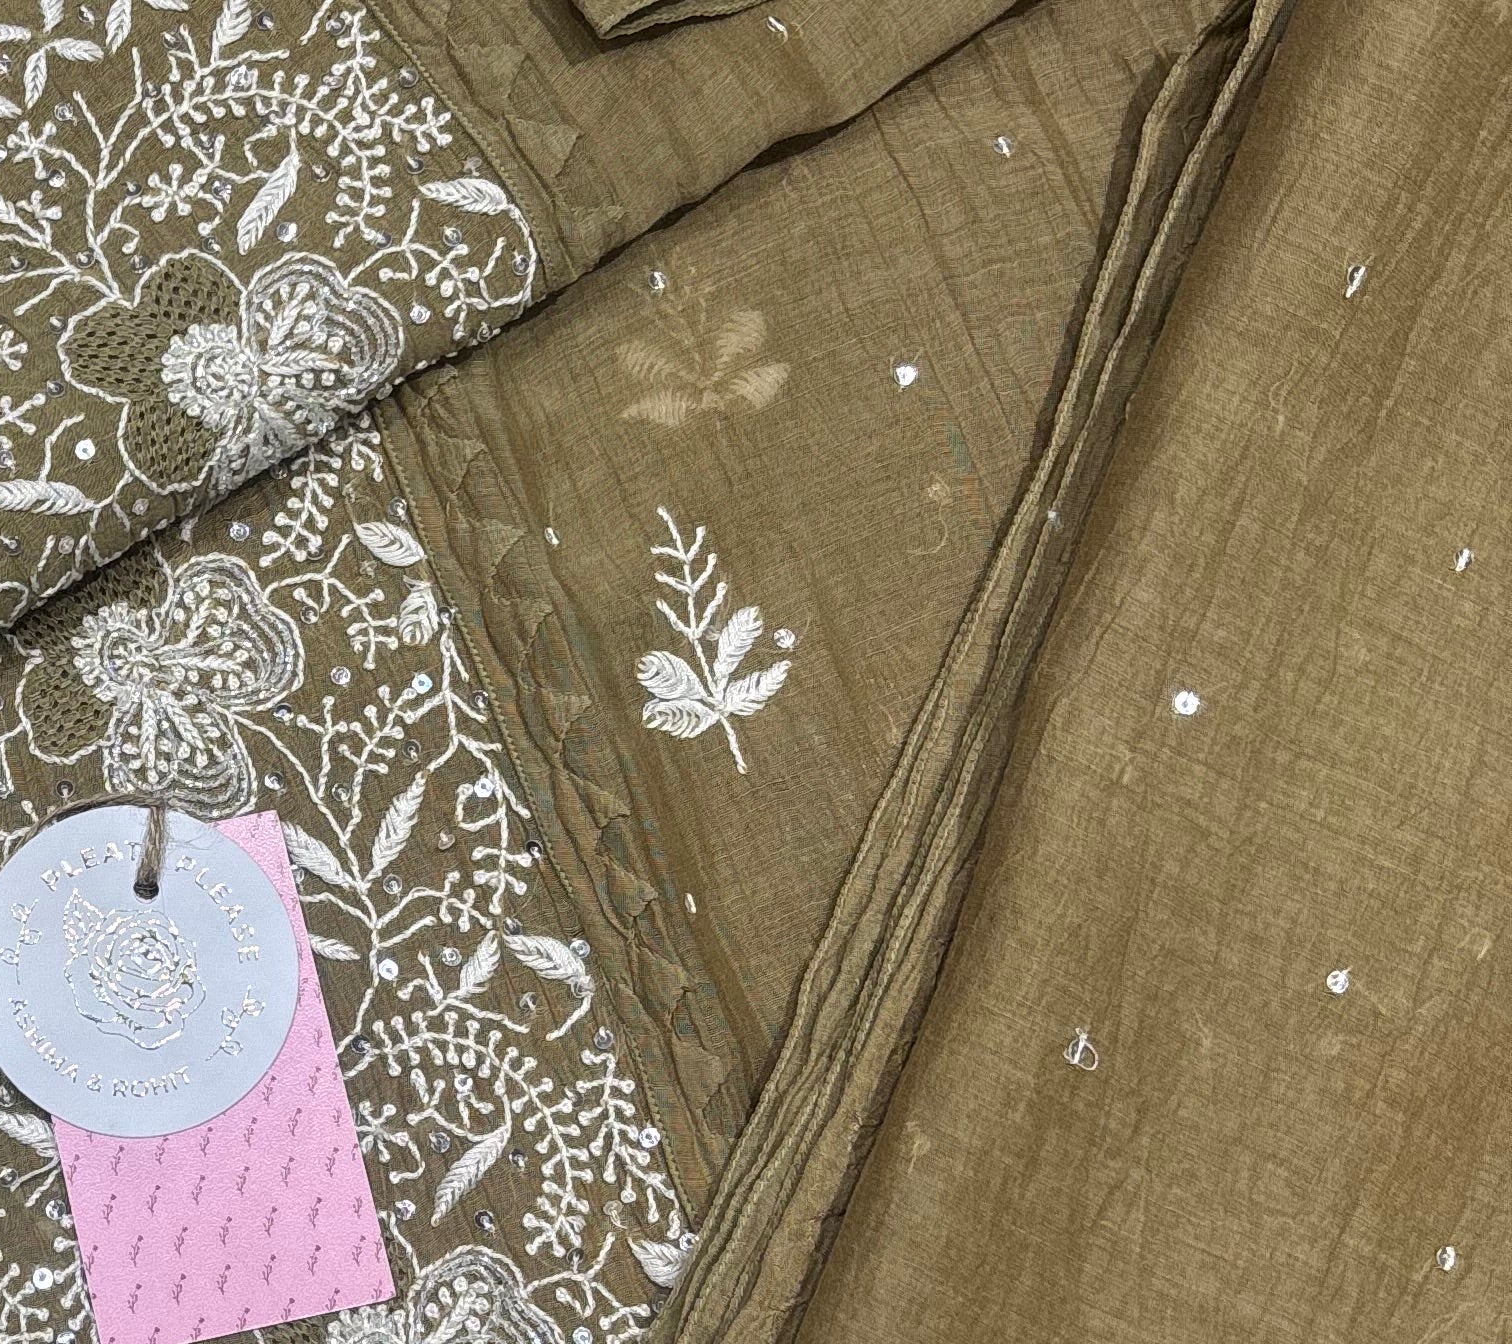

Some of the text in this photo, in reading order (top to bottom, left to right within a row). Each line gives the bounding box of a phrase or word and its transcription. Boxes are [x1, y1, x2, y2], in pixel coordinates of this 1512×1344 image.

[174, 854, 260, 964] PLEASE
[7, 997, 190, 1098] ASHIMA & ROHIT
